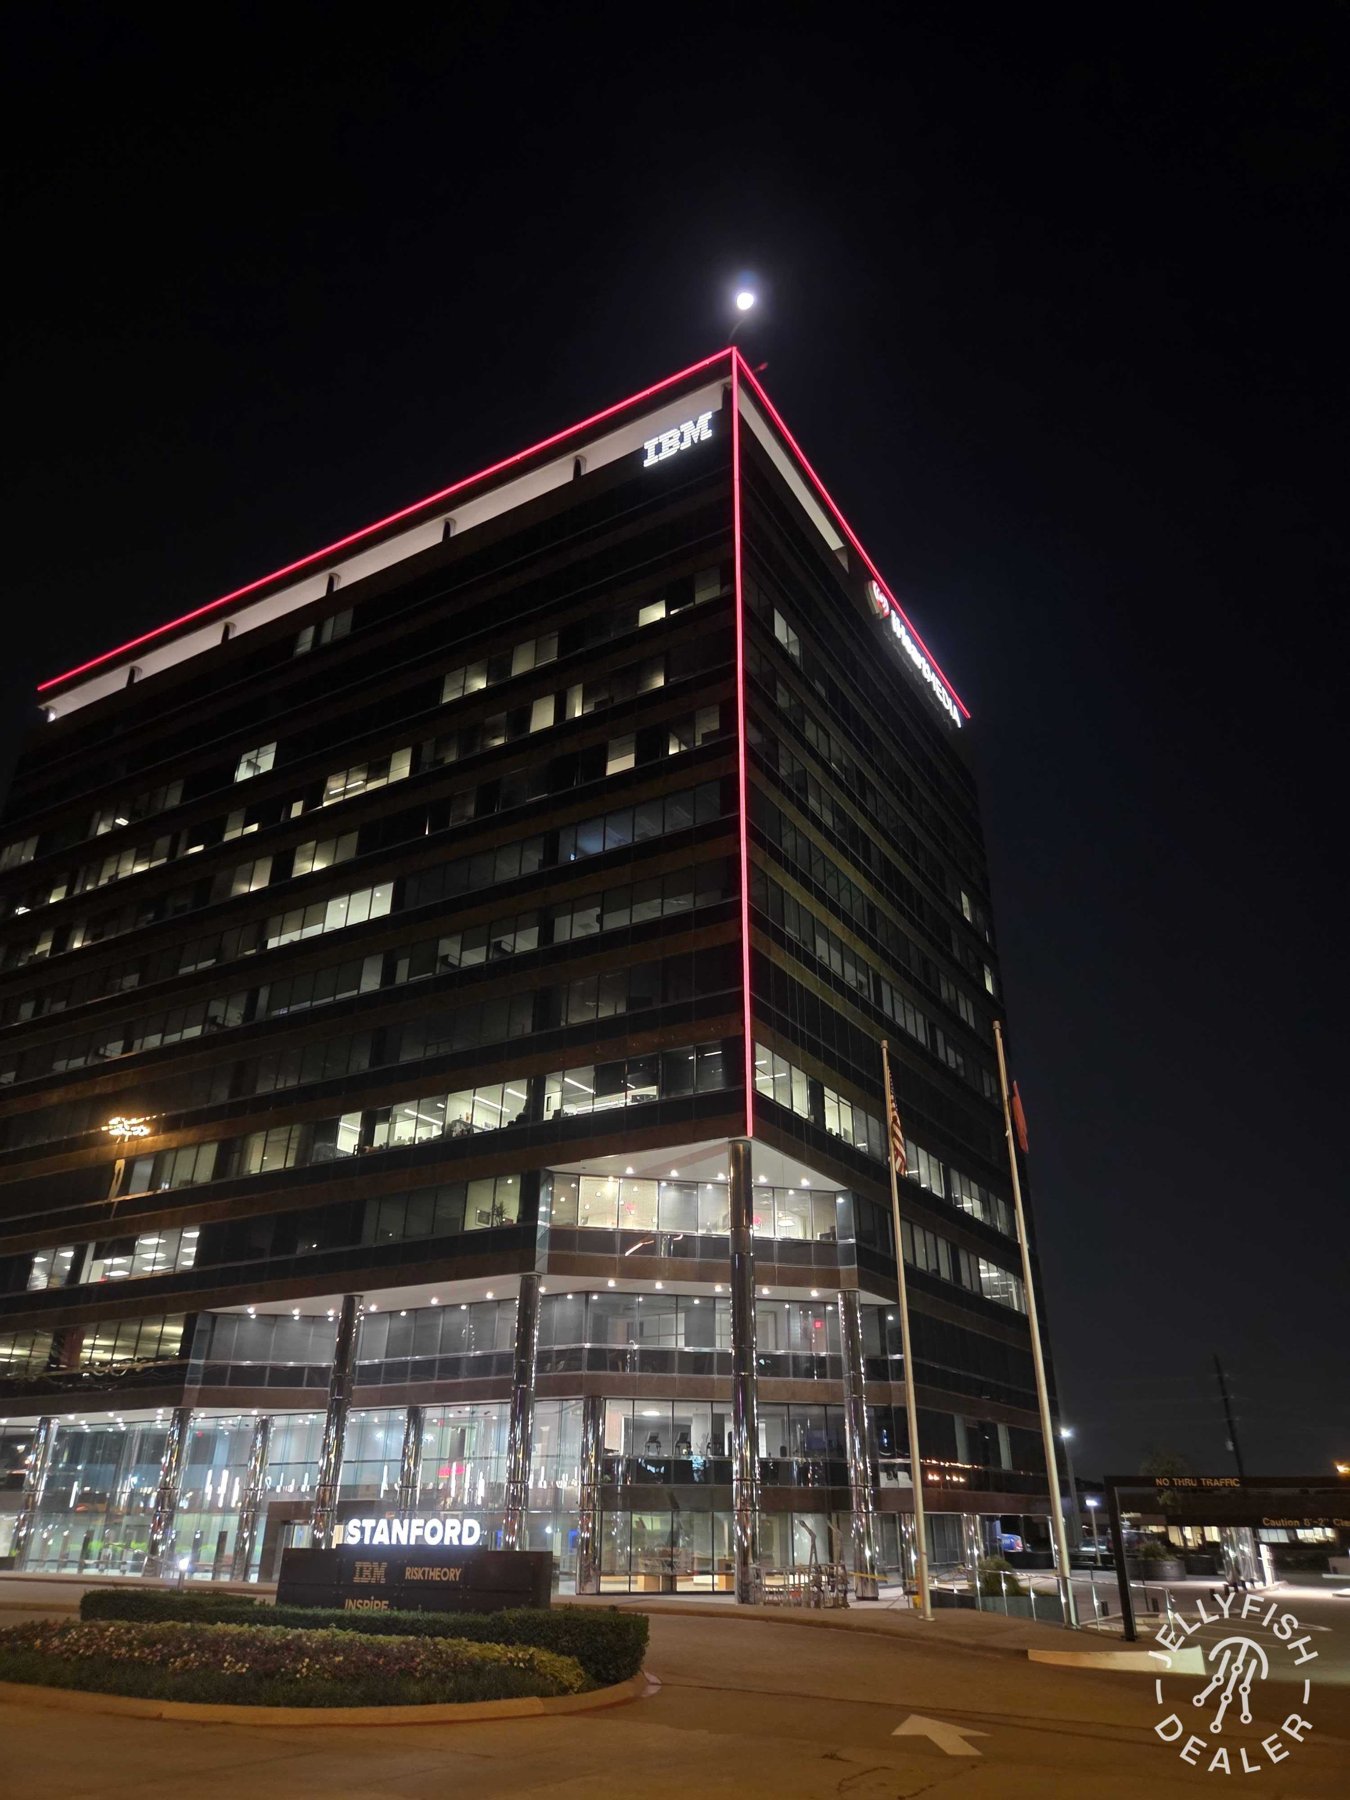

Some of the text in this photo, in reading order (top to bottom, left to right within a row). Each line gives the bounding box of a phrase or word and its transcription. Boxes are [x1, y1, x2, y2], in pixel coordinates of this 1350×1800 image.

[643, 411, 713, 468] IBM
[1155, 1478, 1241, 1488] NO THRU TRAFFIC
[346, 1518, 481, 1545] STANFORD
[1262, 1517, 1300, 1528] Caution
[353, 1561, 388, 1584] IBM
[405, 1566, 462, 1582] RISKTHEORY
